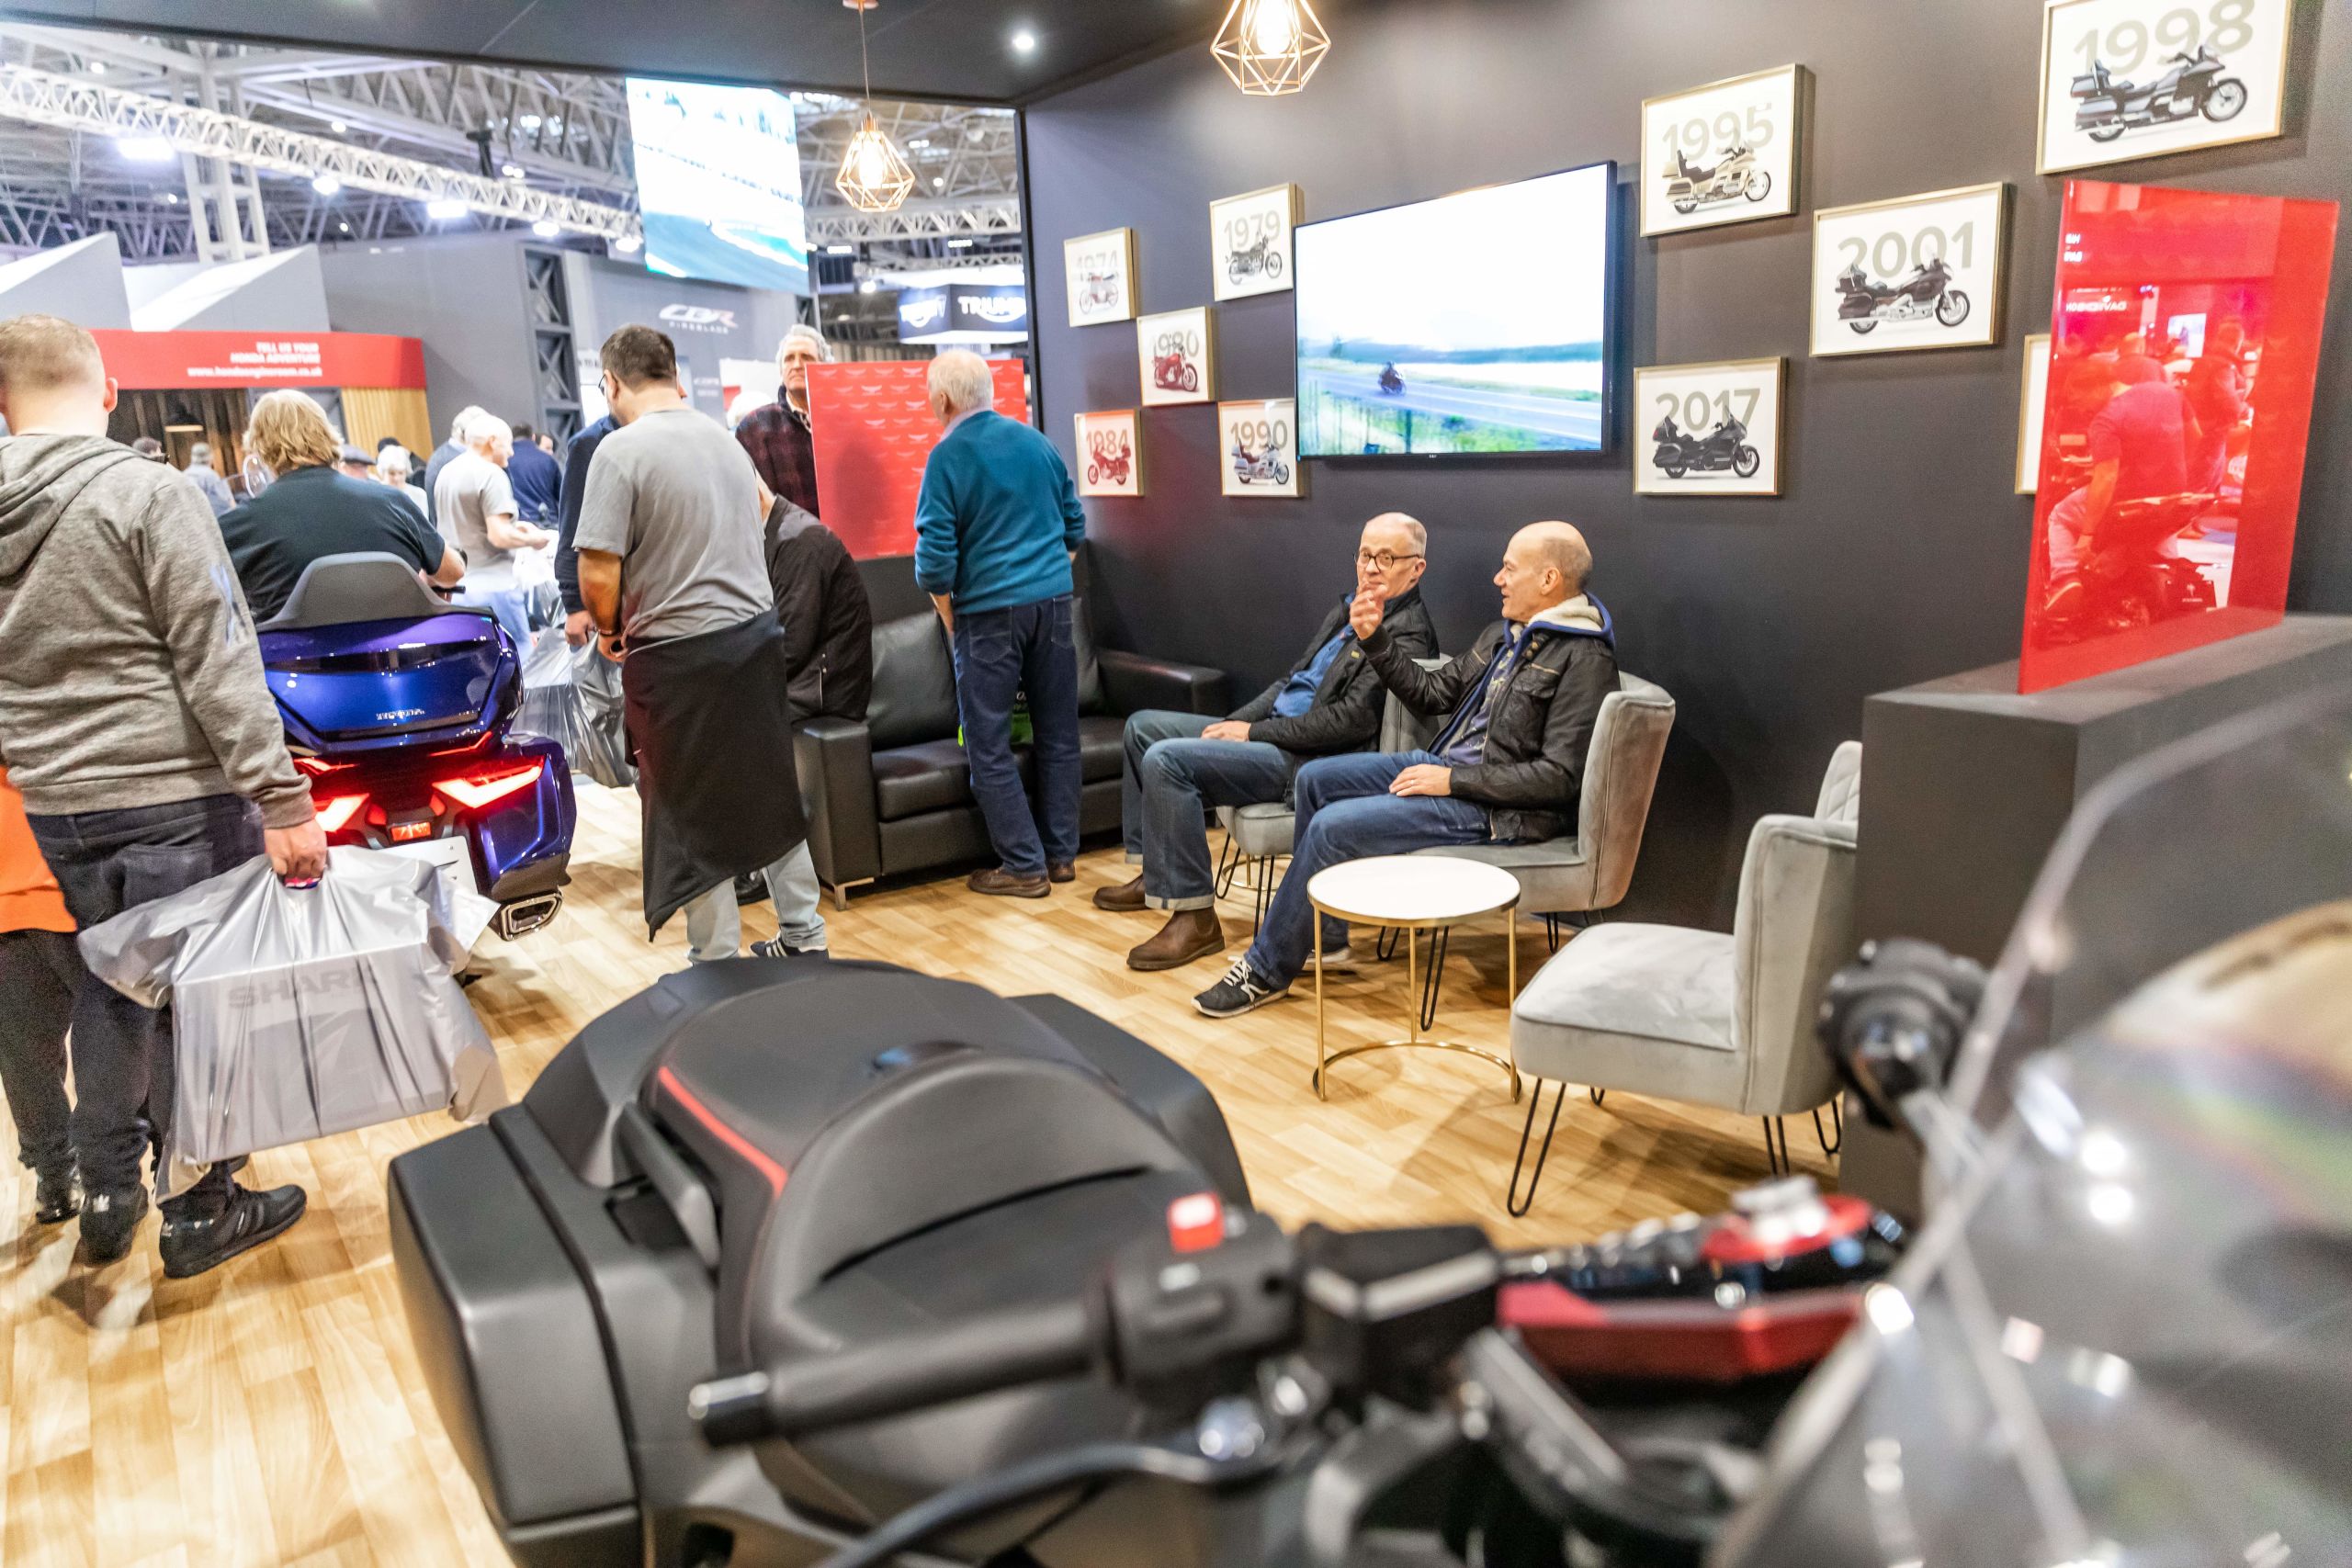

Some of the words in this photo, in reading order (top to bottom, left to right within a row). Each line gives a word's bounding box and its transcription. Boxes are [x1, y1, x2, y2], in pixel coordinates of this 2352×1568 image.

[2074, 0, 2255, 75] 1998
[1662, 102, 1774, 162] 1995
[1224, 209, 1280, 250] 1979
[1838, 220, 1973, 278] 2001
[1655, 388, 1760, 431] 2017
[1087, 429, 1128, 456] 1984
[1230, 420, 1288, 449] 1990
